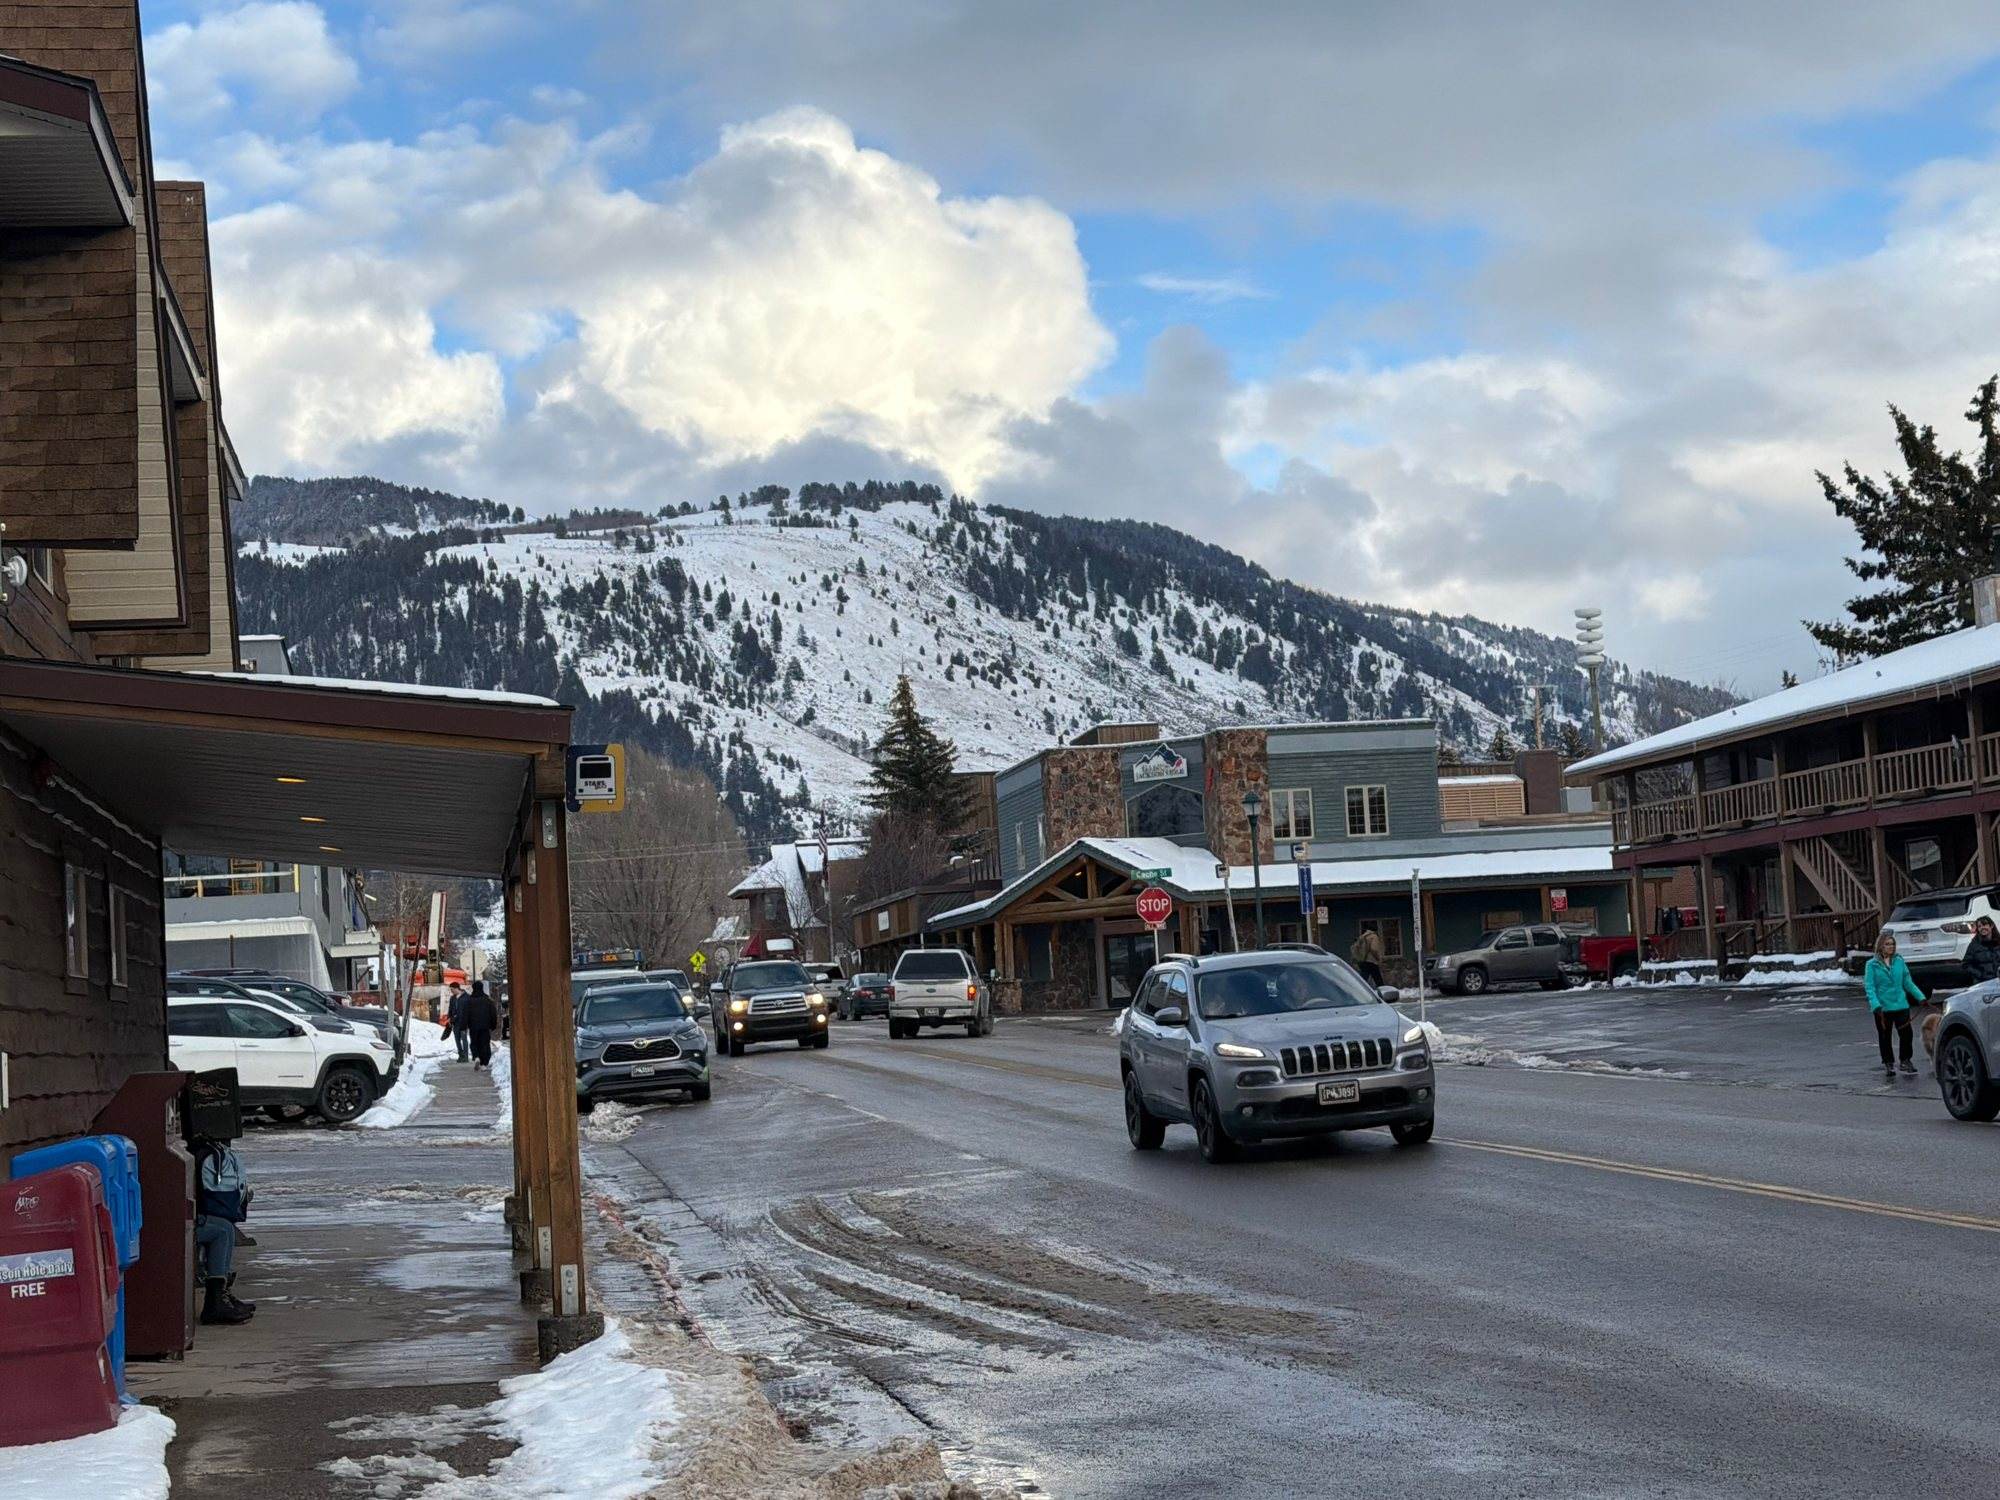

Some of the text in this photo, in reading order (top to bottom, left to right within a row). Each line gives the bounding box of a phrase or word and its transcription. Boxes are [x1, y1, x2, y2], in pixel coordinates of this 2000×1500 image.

[1139, 898, 1169, 913] STOP
[22, 1263, 46, 1278] Hole
[48, 1261, 73, 1275] Daily
[11, 1282, 46, 1299] FREE
